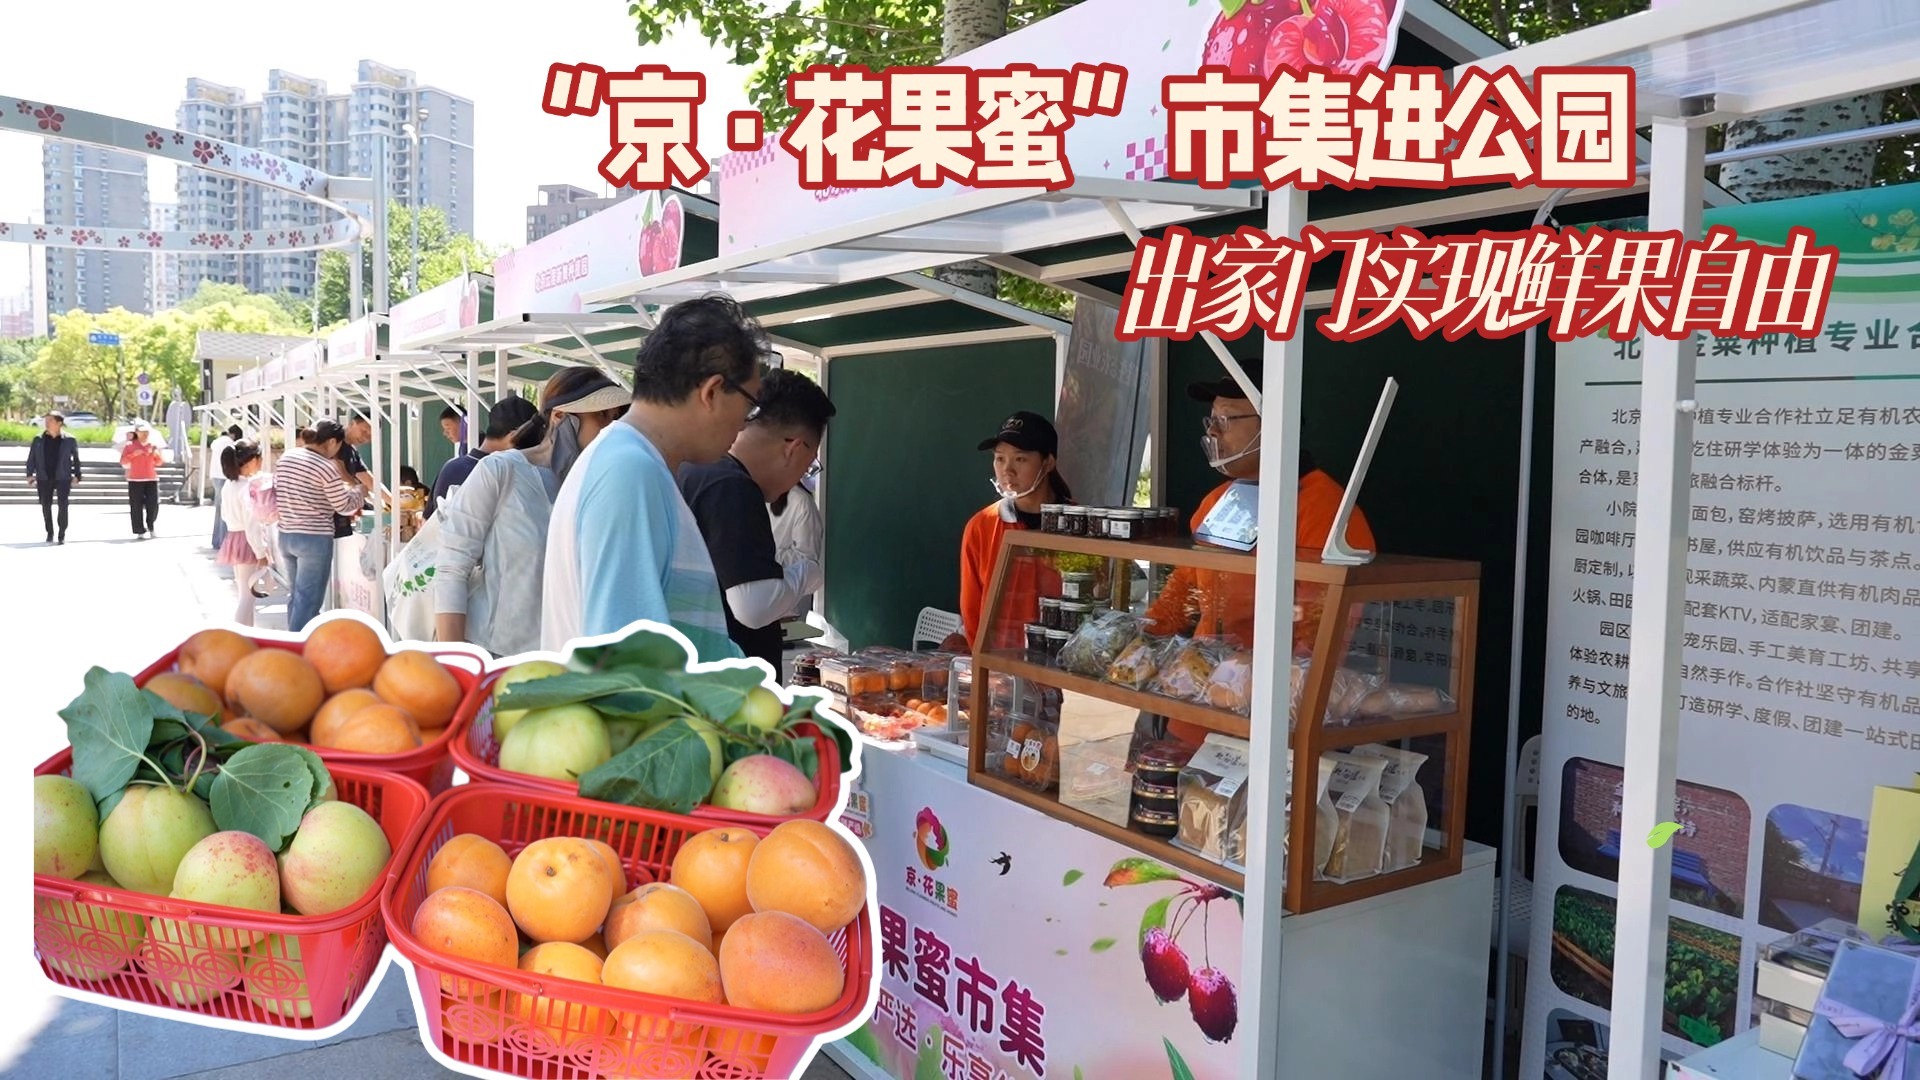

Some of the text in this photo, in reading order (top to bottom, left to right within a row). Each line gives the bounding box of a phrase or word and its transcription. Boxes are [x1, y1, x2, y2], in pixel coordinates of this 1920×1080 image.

[1566, 704, 1600, 725] 的地。
[906, 866, 958, 911] 京·花果蜜
[880, 905, 1045, 1077] 果蜜市集
